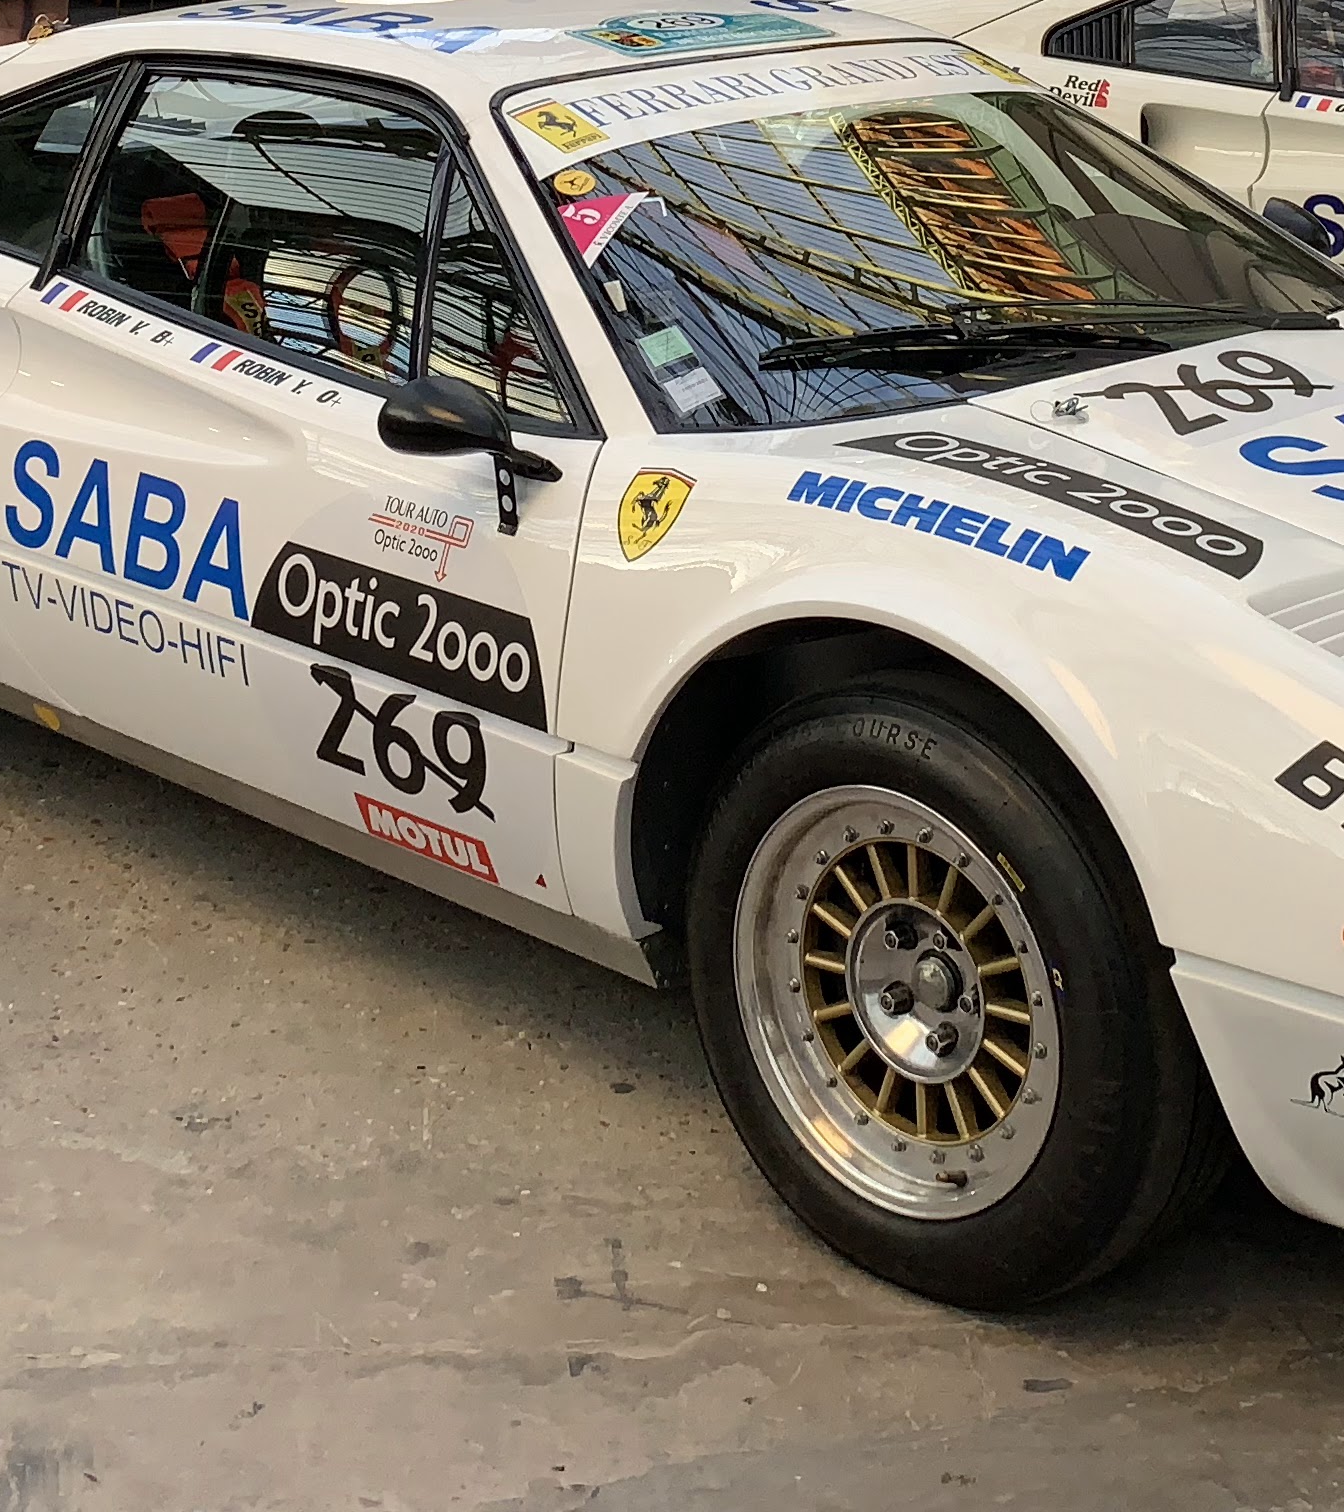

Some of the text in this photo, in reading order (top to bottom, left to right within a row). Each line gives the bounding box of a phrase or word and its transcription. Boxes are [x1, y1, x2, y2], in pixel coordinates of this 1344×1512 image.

[566, 70, 784, 128] FERRARI
[767, 55, 924, 91] GRAND
[1064, 74, 1101, 92] Red
[76, 298, 132, 328] ROBIN
[128, 320, 151, 336] V.
[232, 358, 293, 387] ROBIN
[290, 379, 313, 396] Y.
[1102, 349, 1334, 437] 269
[5, 440, 250, 622] SABA
[384, 495, 448, 528] TOUR AUTO
[395, 520, 425, 536] 2020
[785, 470, 1092, 582] MICHELIN
[893, 432, 1250, 559] Optic 2000
[374, 528, 438, 562] Optic 2000
[1, 560, 251, 686] TV-VIDEO-HIFI
[277, 553, 531, 693] Optic 2000
[310, 662, 497, 823] 269
[367, 803, 491, 873] MOTUL
